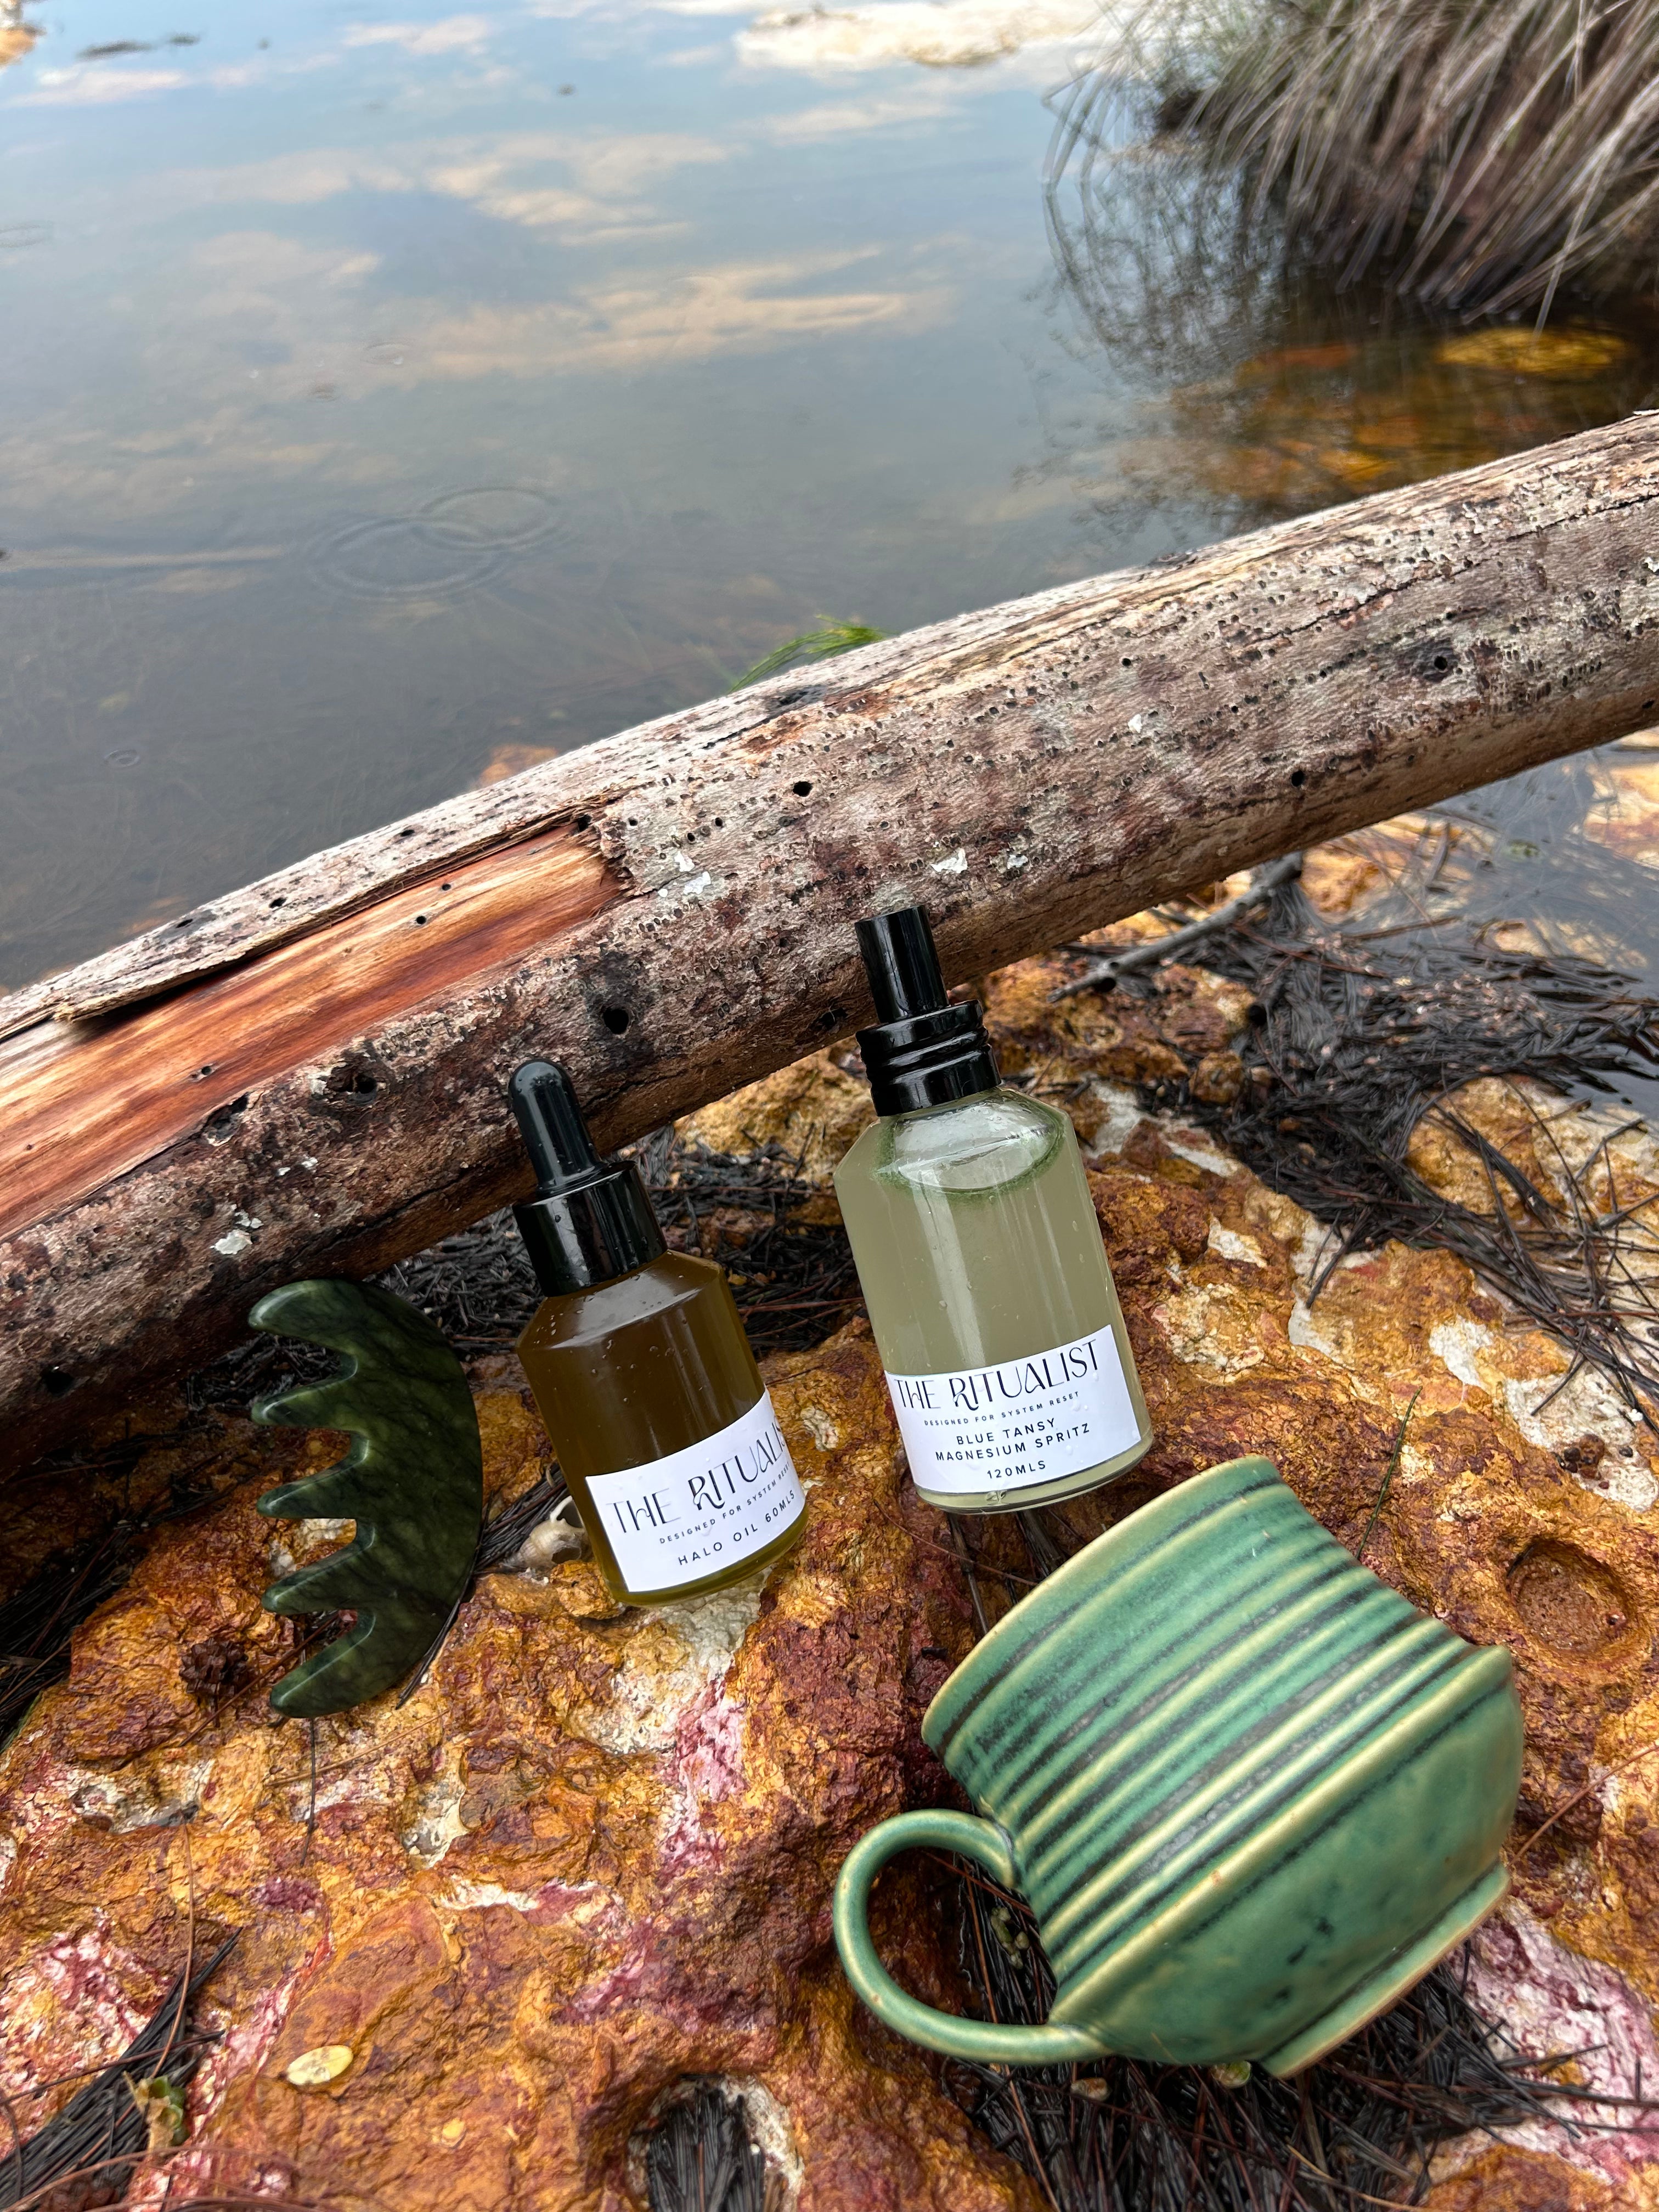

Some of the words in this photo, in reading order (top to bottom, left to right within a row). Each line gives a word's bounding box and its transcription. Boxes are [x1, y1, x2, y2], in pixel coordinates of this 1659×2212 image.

[894, 1379, 941, 1409] THE
[949, 1339, 1097, 1410] RITUALIST
[1002, 1403, 1043, 1418] SYSTEM
[1049, 1391, 1079, 1406] RESET
[935, 1442, 1026, 1461] MAGNESIUM
[1035, 1423, 1090, 1448] SPRITZ
[956, 1432, 995, 1445] BLUE
[1002, 1418, 1055, 1438] TANSY
[987, 1460, 1046, 1479] 120MLS
[606, 1488, 681, 1533] THE
[659, 1519, 716, 1544] DESIGNED
[723, 1505, 742, 1519] FOR
[747, 1480, 777, 1505] SYSTEM
[778, 1461, 791, 1480] RESET
[678, 1542, 723, 1565] HALO
[733, 1523, 758, 1542] OIL
[765, 1489, 795, 1523] 60MLS
